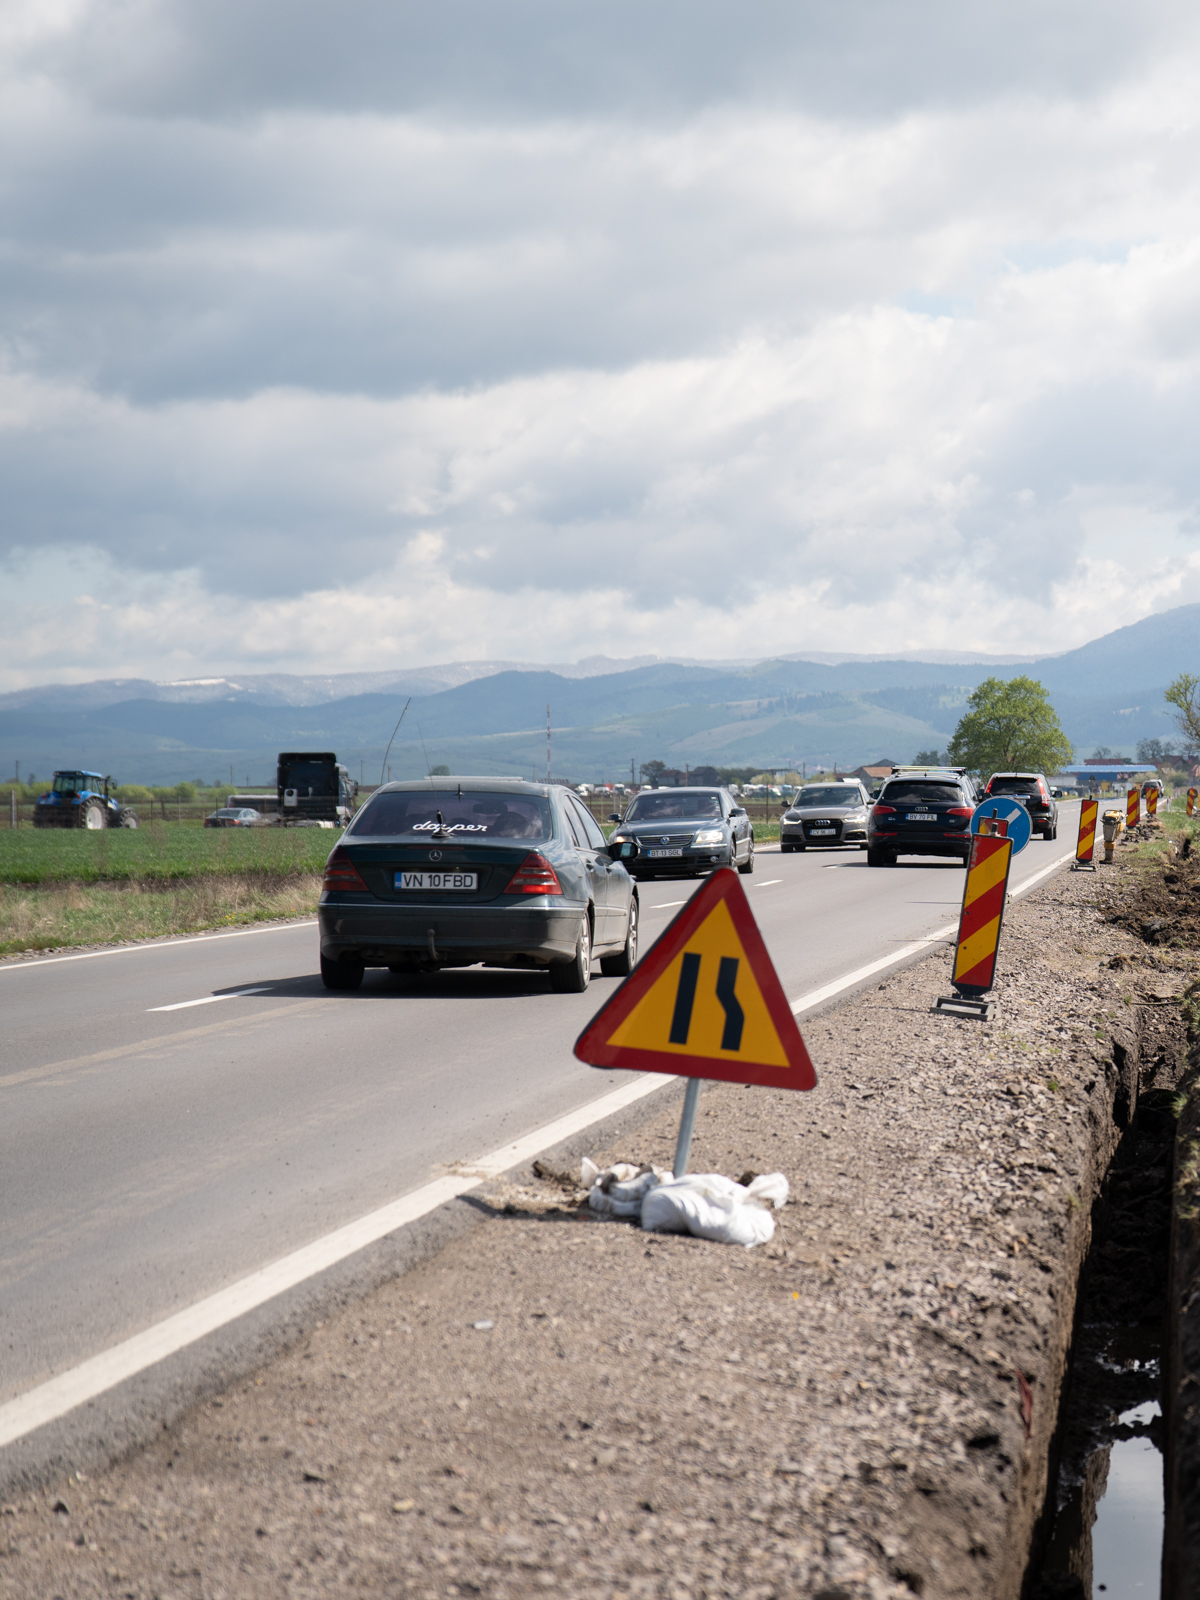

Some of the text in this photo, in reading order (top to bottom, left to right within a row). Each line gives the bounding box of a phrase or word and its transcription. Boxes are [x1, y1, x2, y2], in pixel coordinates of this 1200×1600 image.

[403, 874, 473, 887] VN 10 FBD
